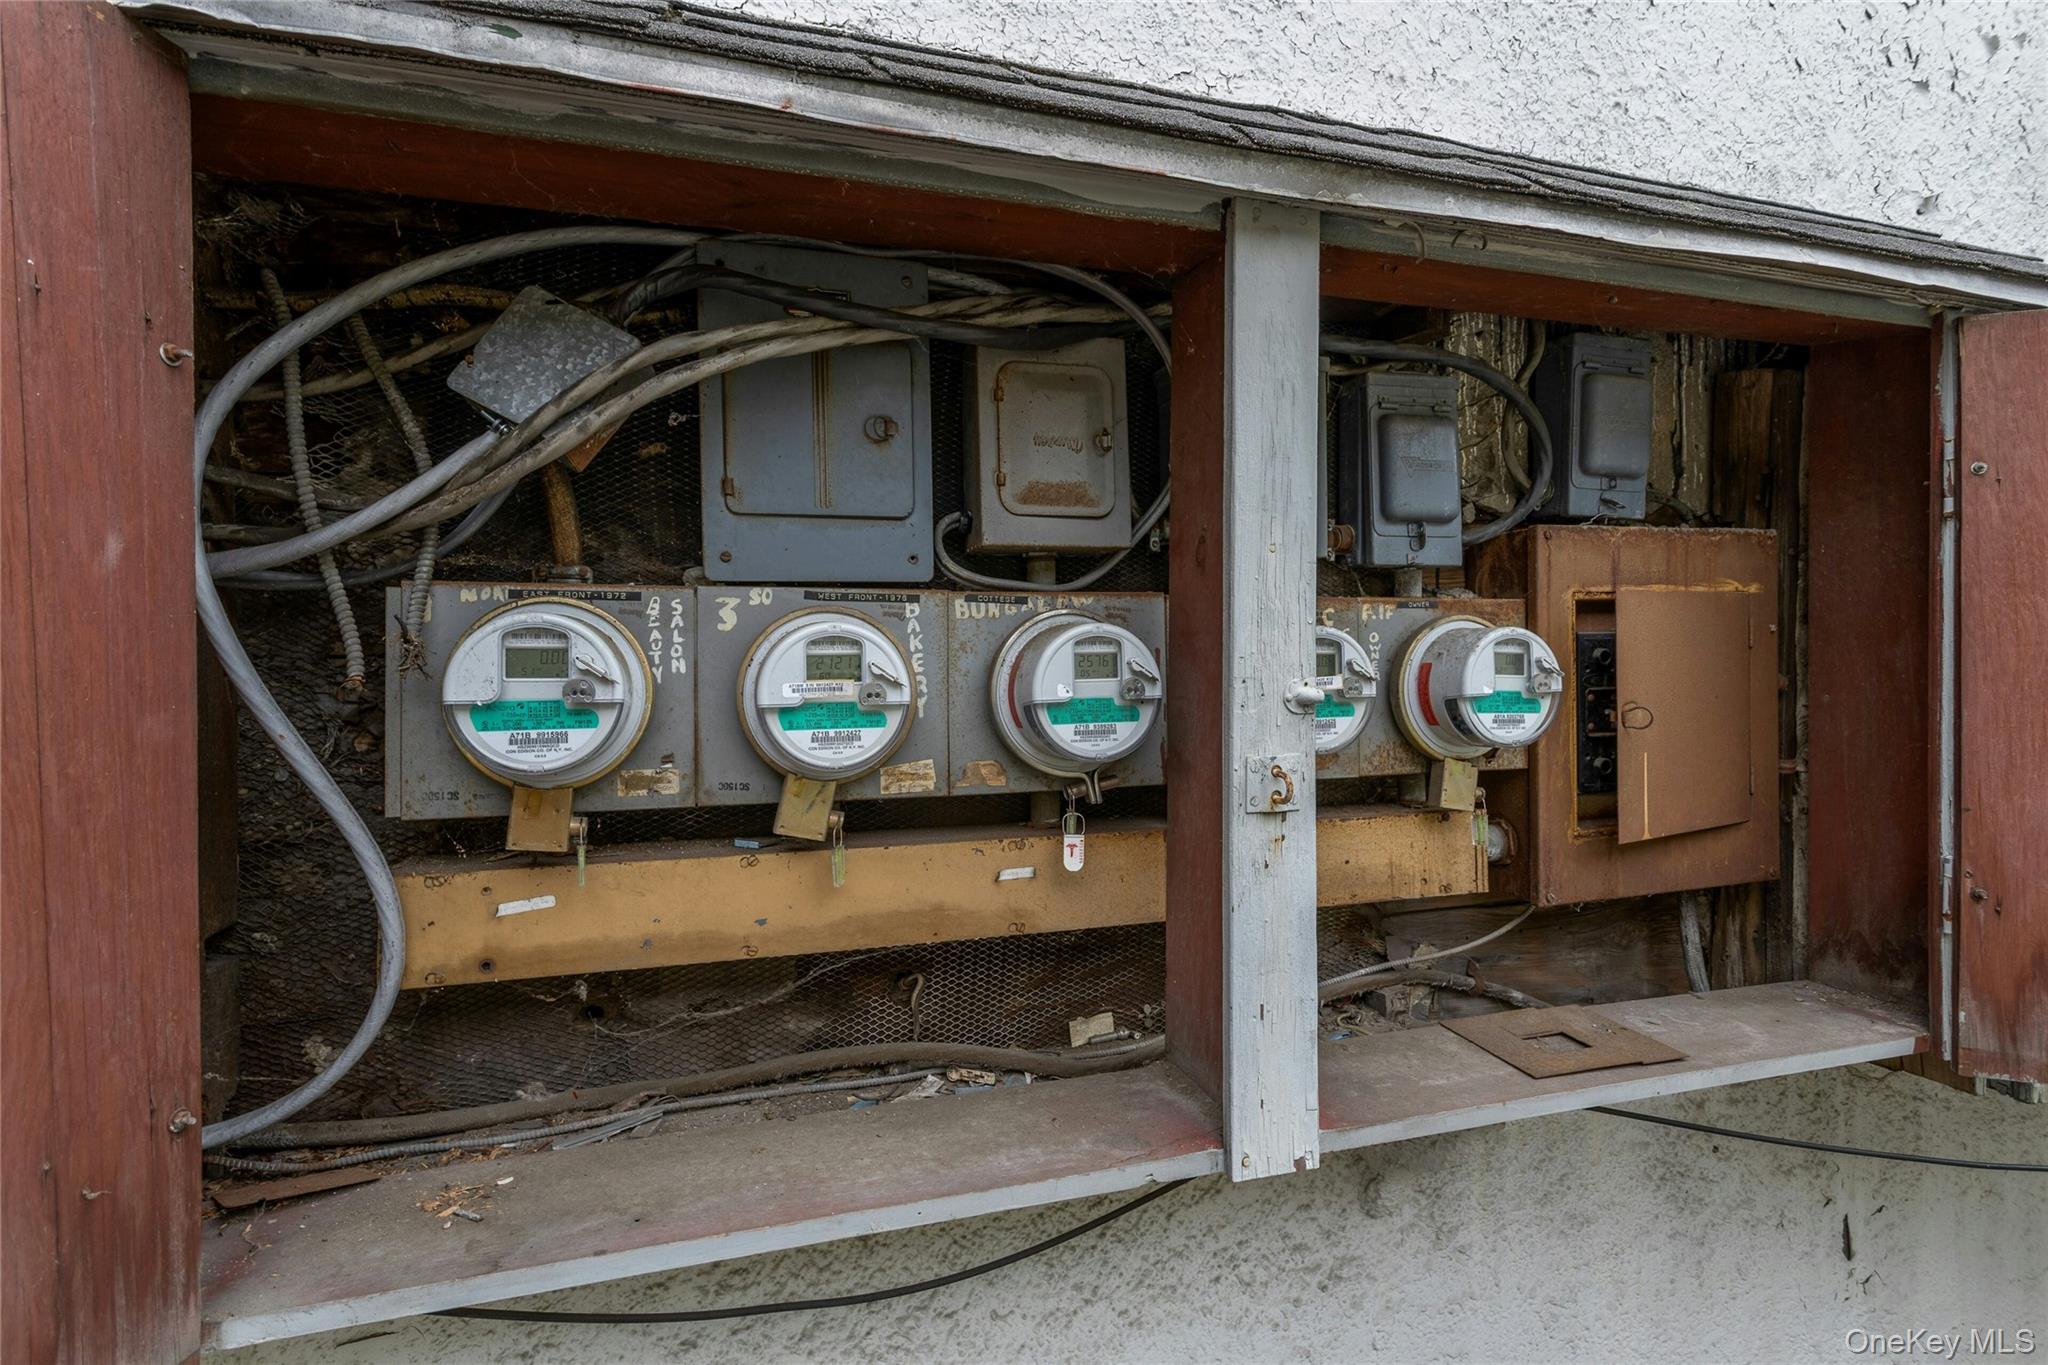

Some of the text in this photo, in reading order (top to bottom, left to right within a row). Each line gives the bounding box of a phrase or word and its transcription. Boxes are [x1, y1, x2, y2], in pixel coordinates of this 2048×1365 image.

[522, 590, 550, 599] EAST
[817, 592, 841, 600] WEST
[715, 597, 741, 632] 3
[646, 596, 663, 684] BEAUTY
[670, 599, 687, 674] SALON
[1078, 654, 1109, 668] 2576
[1368, 631, 1381, 681] OWNER
[509, 731, 531, 739] A71B
